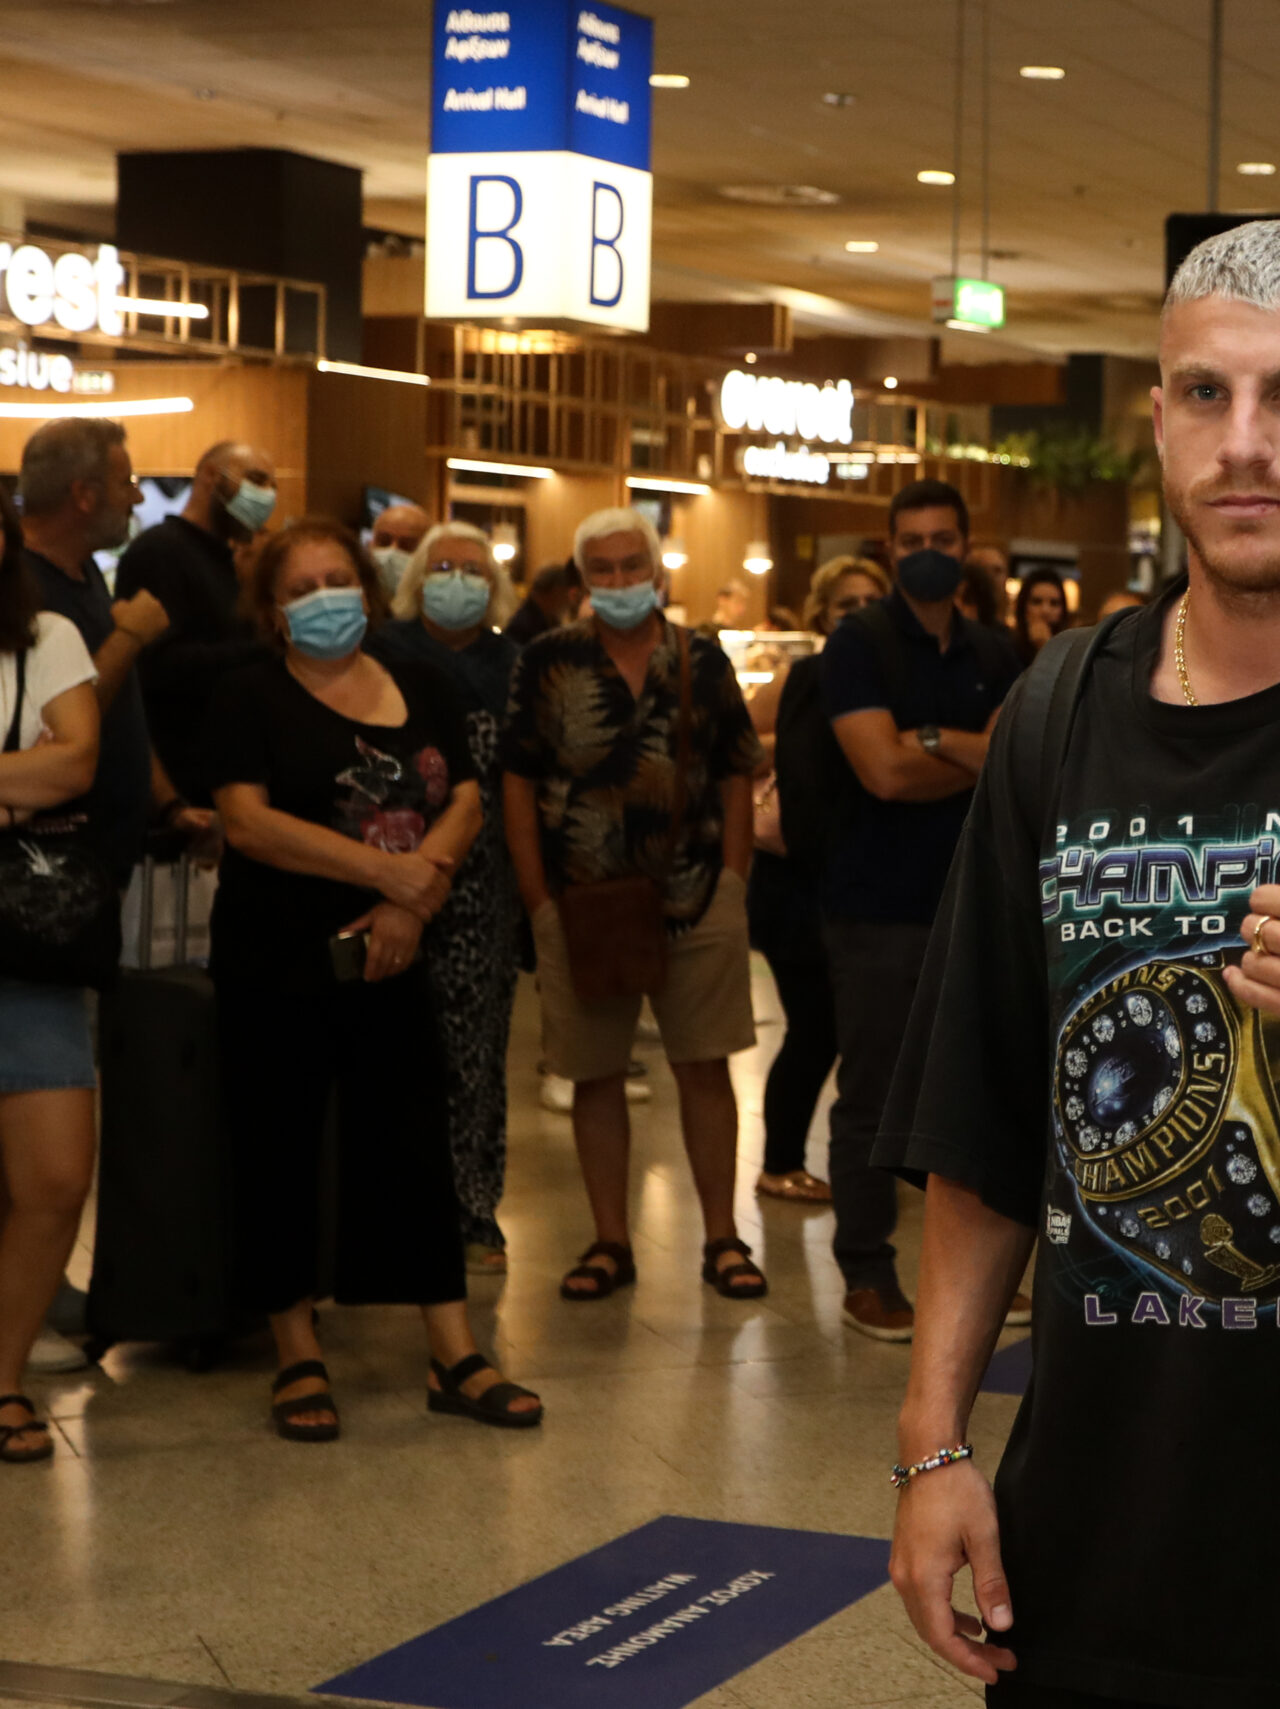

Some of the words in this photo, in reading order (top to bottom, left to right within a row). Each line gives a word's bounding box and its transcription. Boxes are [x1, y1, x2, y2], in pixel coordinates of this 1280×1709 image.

[466, 174, 524, 300] B
[589, 181, 624, 308] B
[1060, 915, 1153, 943] BACK
[1175, 914, 1226, 936] TO
[1137, 1164, 1226, 1230] 2001
[603, 1573, 698, 1617] WAITING
[540, 1614, 613, 1647] AREA
